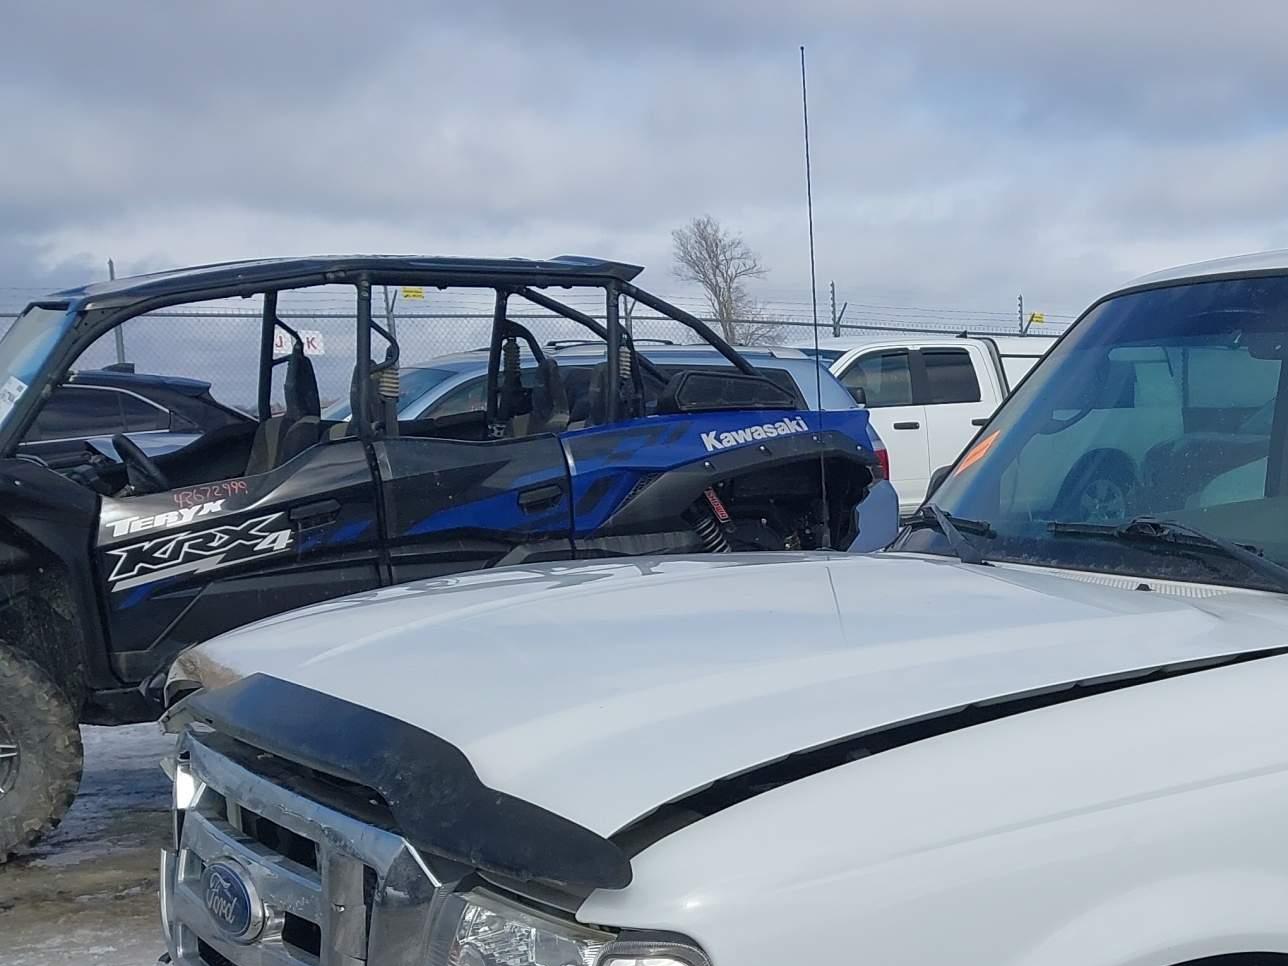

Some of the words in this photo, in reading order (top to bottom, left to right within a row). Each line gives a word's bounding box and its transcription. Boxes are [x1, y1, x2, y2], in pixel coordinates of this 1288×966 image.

[306, 336, 318, 350] K
[700, 416, 808, 452] Kawasaki
[206, 871, 238, 925] Ford
